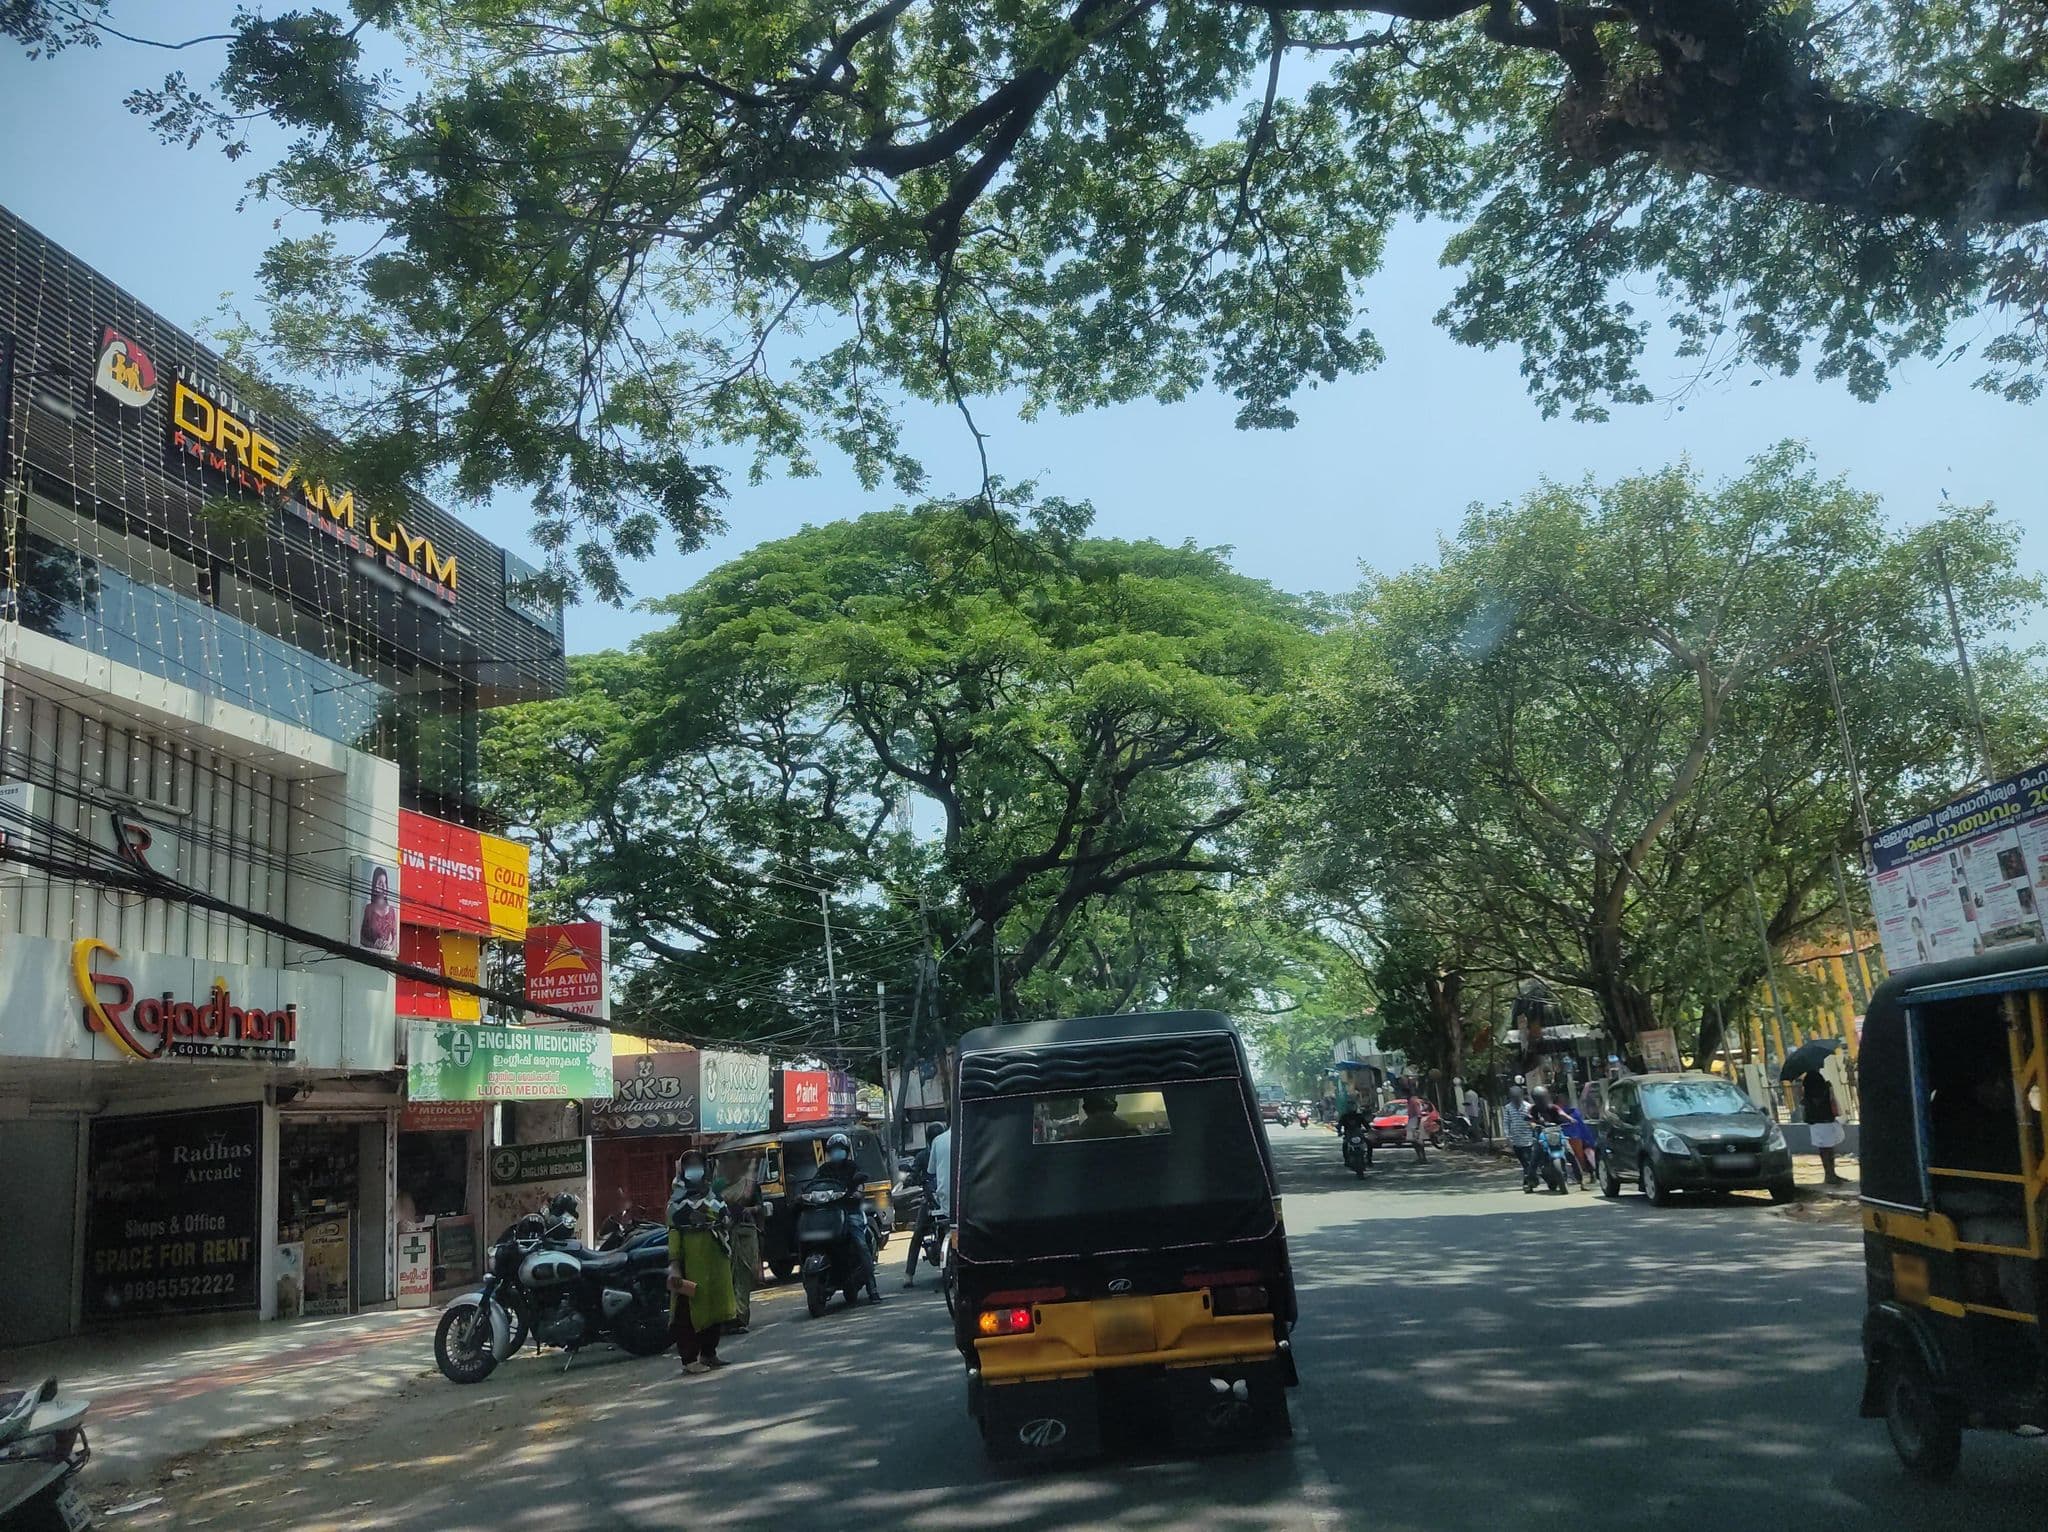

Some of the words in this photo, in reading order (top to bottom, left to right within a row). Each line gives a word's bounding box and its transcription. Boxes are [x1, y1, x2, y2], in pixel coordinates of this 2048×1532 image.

[178, 365, 256, 424] JAISON'S
[174, 382, 354, 528] DREAM
[174, 431, 267, 494] FAMILY
[282, 496, 375, 558] ITNESS
[386, 554, 457, 604] CENTRE
[397, 848, 425, 869] IVA
[428, 855, 482, 881] FINVEST
[494, 867, 525, 888] GOLD
[493, 887, 524, 909] LOAN
[530, 977, 555, 988] KLM
[530, 987, 575, 999] FINVEST
[579, 985, 598, 995] LTD
[82, 970, 297, 1060] Rajadhani
[179, 1044, 208, 1055] GOLD
[477, 1031, 531, 1050] ENGLISH
[534, 1034, 593, 1053] MEDICINES
[477, 1085, 513, 1096] LUCIA
[515, 1085, 568, 1096] MEDICALS
[613, 1076, 682, 1100] KKB
[418, 1106, 473, 1115] MEDICALS
[592, 1094, 695, 1115] Restaurant
[173, 1142, 252, 1164] Radhas
[185, 1163, 241, 1183] Arcade
[521, 1166, 548, 1178] ENGLISH
[549, 1161, 583, 1175] MEDICINES
[125, 1218, 165, 1239] Shops
[170, 1215, 180, 1234] &
[185, 1212, 225, 1232] Office
[95, 1245, 152, 1273] SPACE
[160, 1242, 195, 1267] FOR
[203, 1237, 251, 1264] RENT
[124, 1272, 235, 1300] 9895552222
